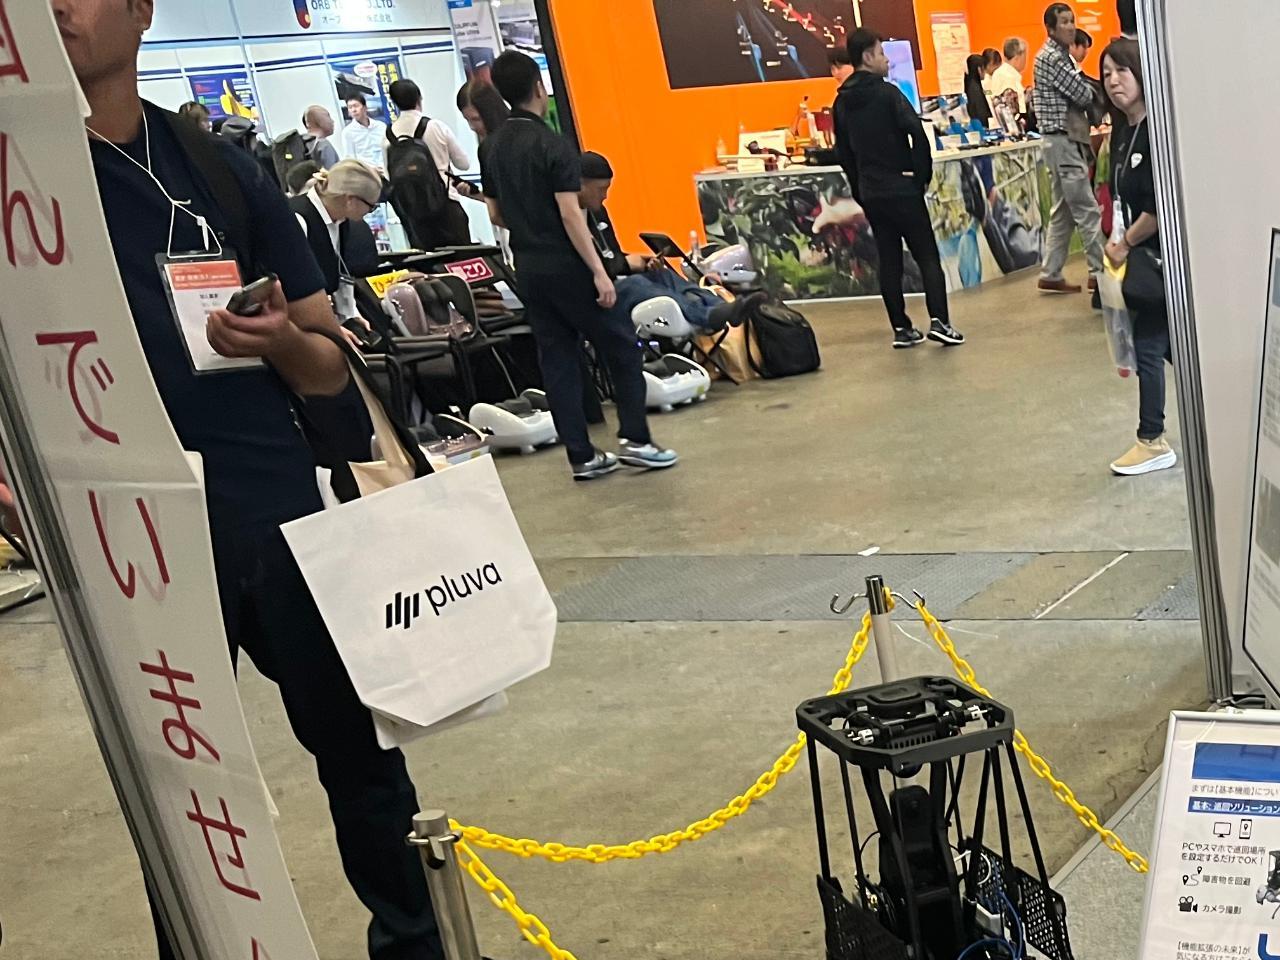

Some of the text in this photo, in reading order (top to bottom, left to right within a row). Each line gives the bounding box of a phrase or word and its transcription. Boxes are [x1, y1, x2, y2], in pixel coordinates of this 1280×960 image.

[424, 562, 502, 616] pluva
[1182, 842, 1266, 854] PCやスマホで巡回場所
[1202, 875, 1251, 886] 障害物を回避
[1202, 904, 1242, 915] カメラ撮影
